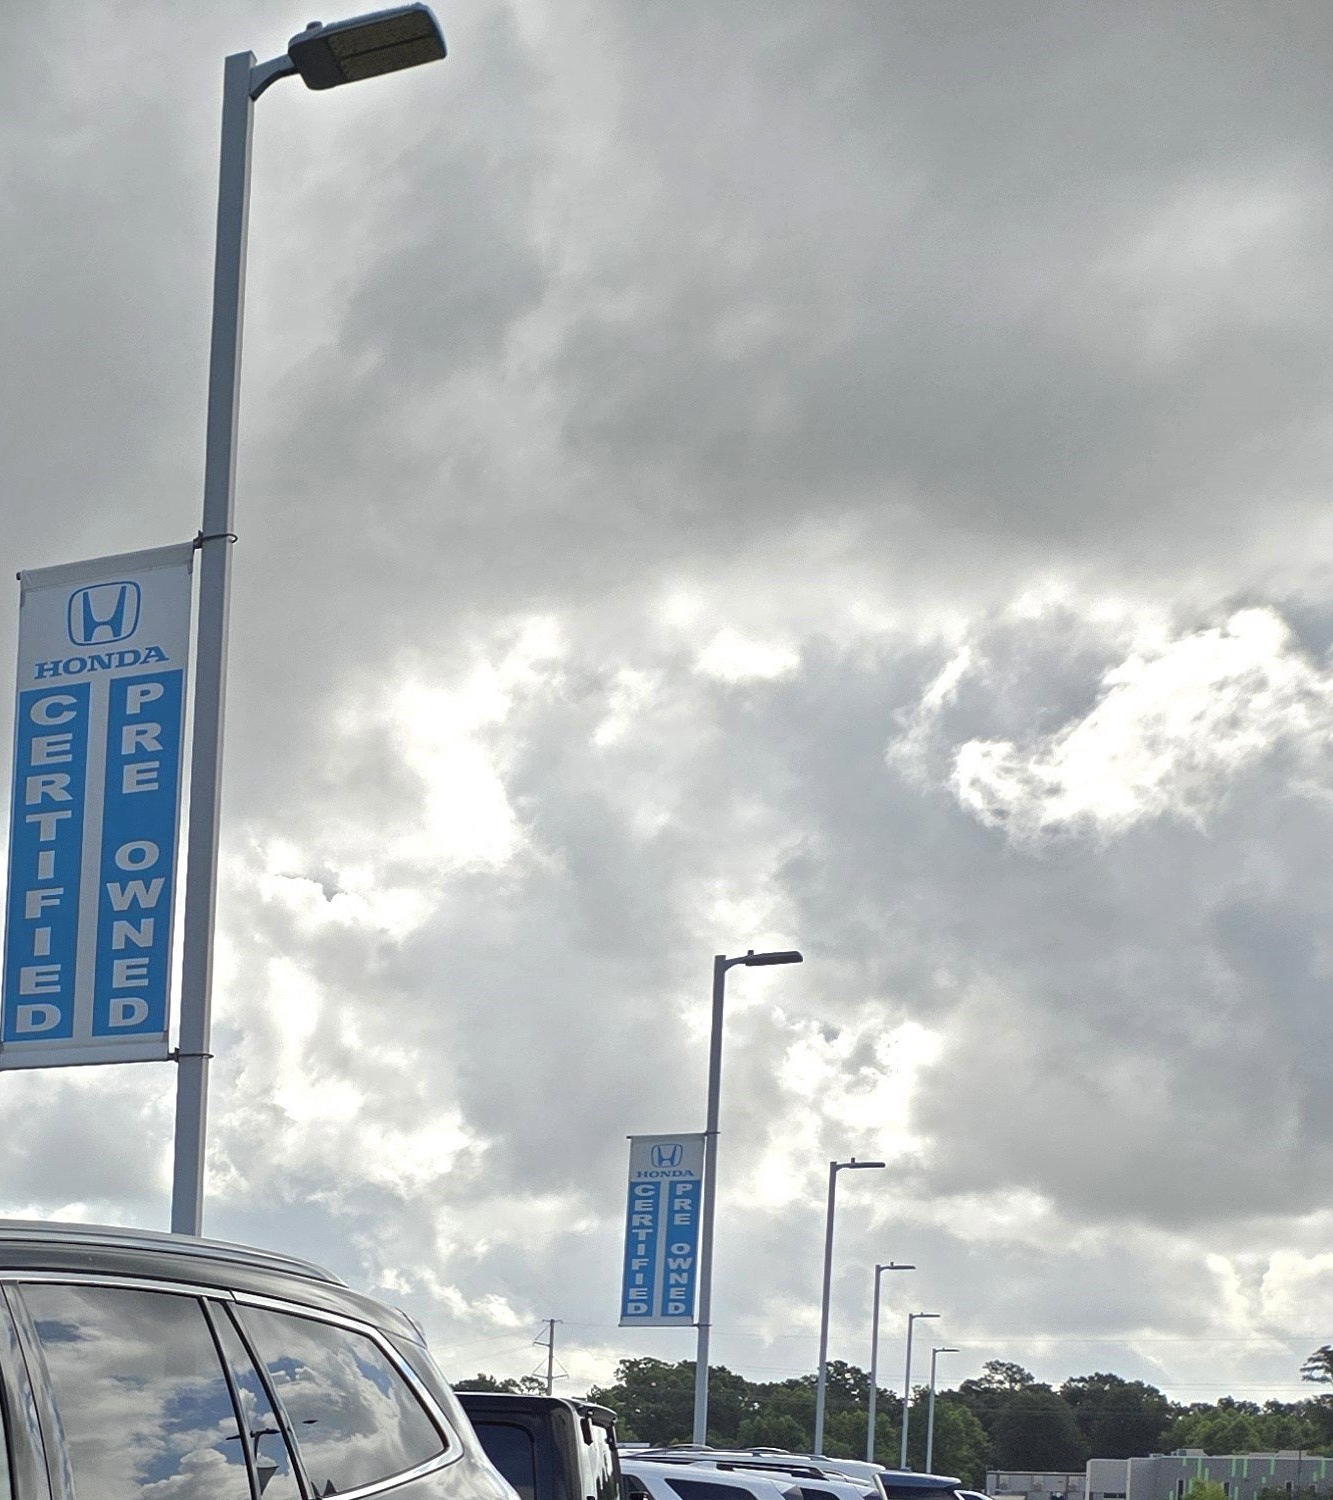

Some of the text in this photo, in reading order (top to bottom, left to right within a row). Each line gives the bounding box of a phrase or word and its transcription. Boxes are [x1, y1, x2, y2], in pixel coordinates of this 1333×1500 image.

[34, 645, 170, 680] HONDA
[15, 694, 78, 1034] CERTIFIED
[106, 682, 166, 1028] PRE OWNED
[636, 1169, 695, 1179] HONDA
[626, 1183, 656, 1315] CERTIFIED
[667, 1183, 694, 1315] PRE OWNED
